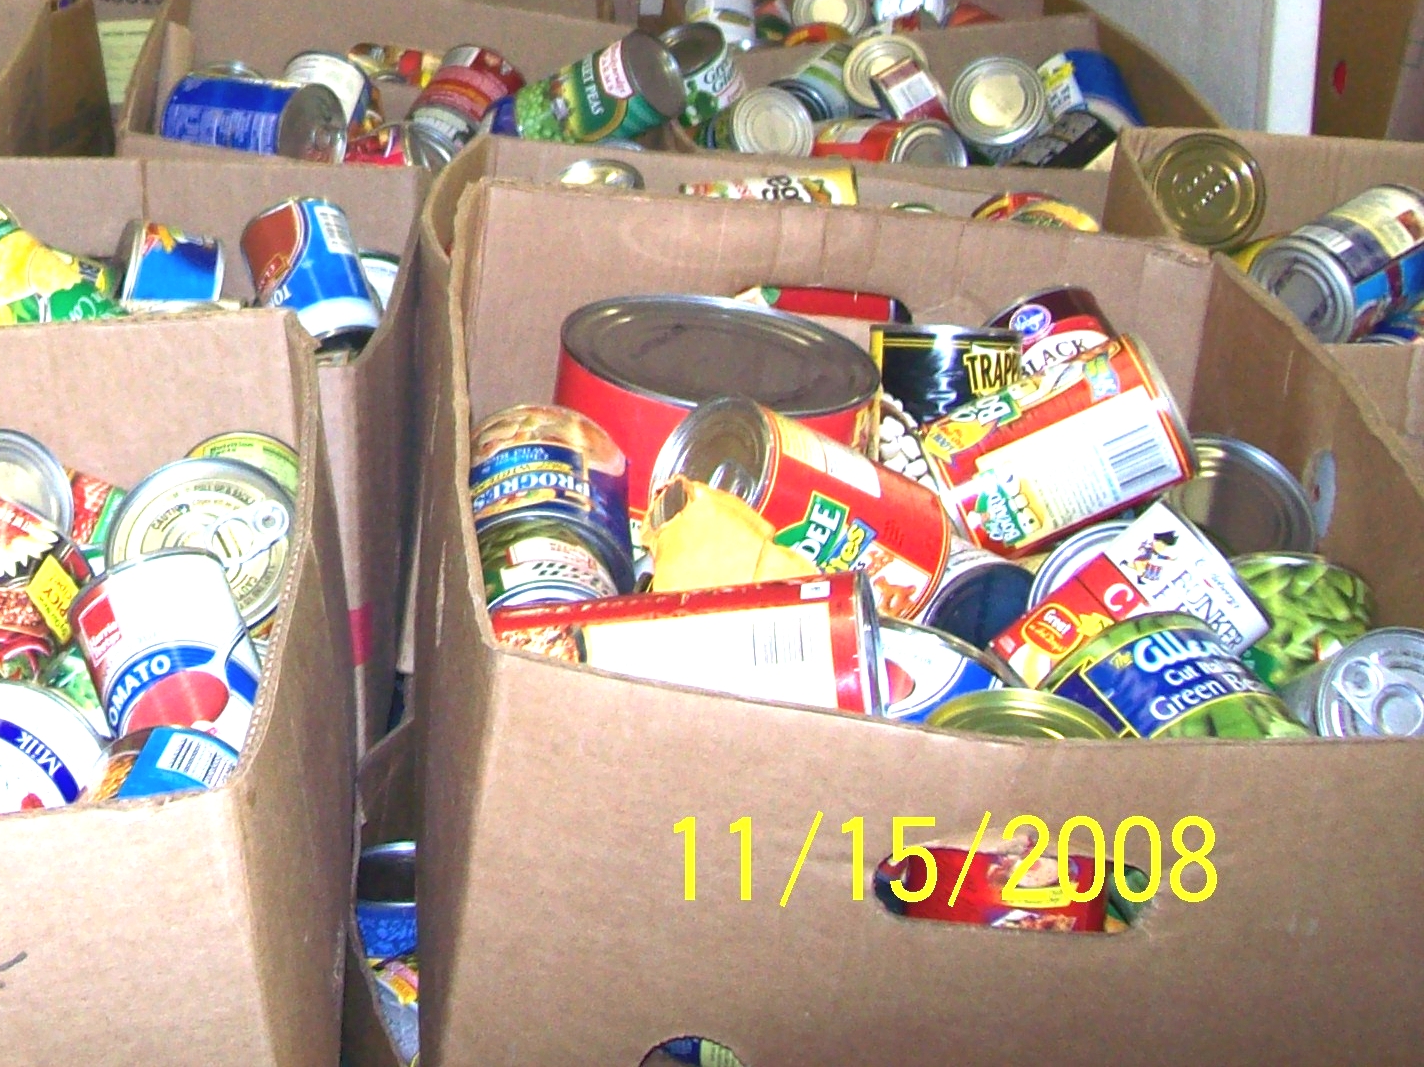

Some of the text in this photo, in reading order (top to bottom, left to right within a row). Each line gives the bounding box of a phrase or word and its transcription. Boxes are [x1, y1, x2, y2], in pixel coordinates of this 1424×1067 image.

[1042, 608, 1072, 636] Great
[1173, 569, 1243, 648] BUNKER
[1163, 664, 1201, 686] Cut
[1149, 679, 1228, 721] Green
[14, 730, 64, 777] Milk
